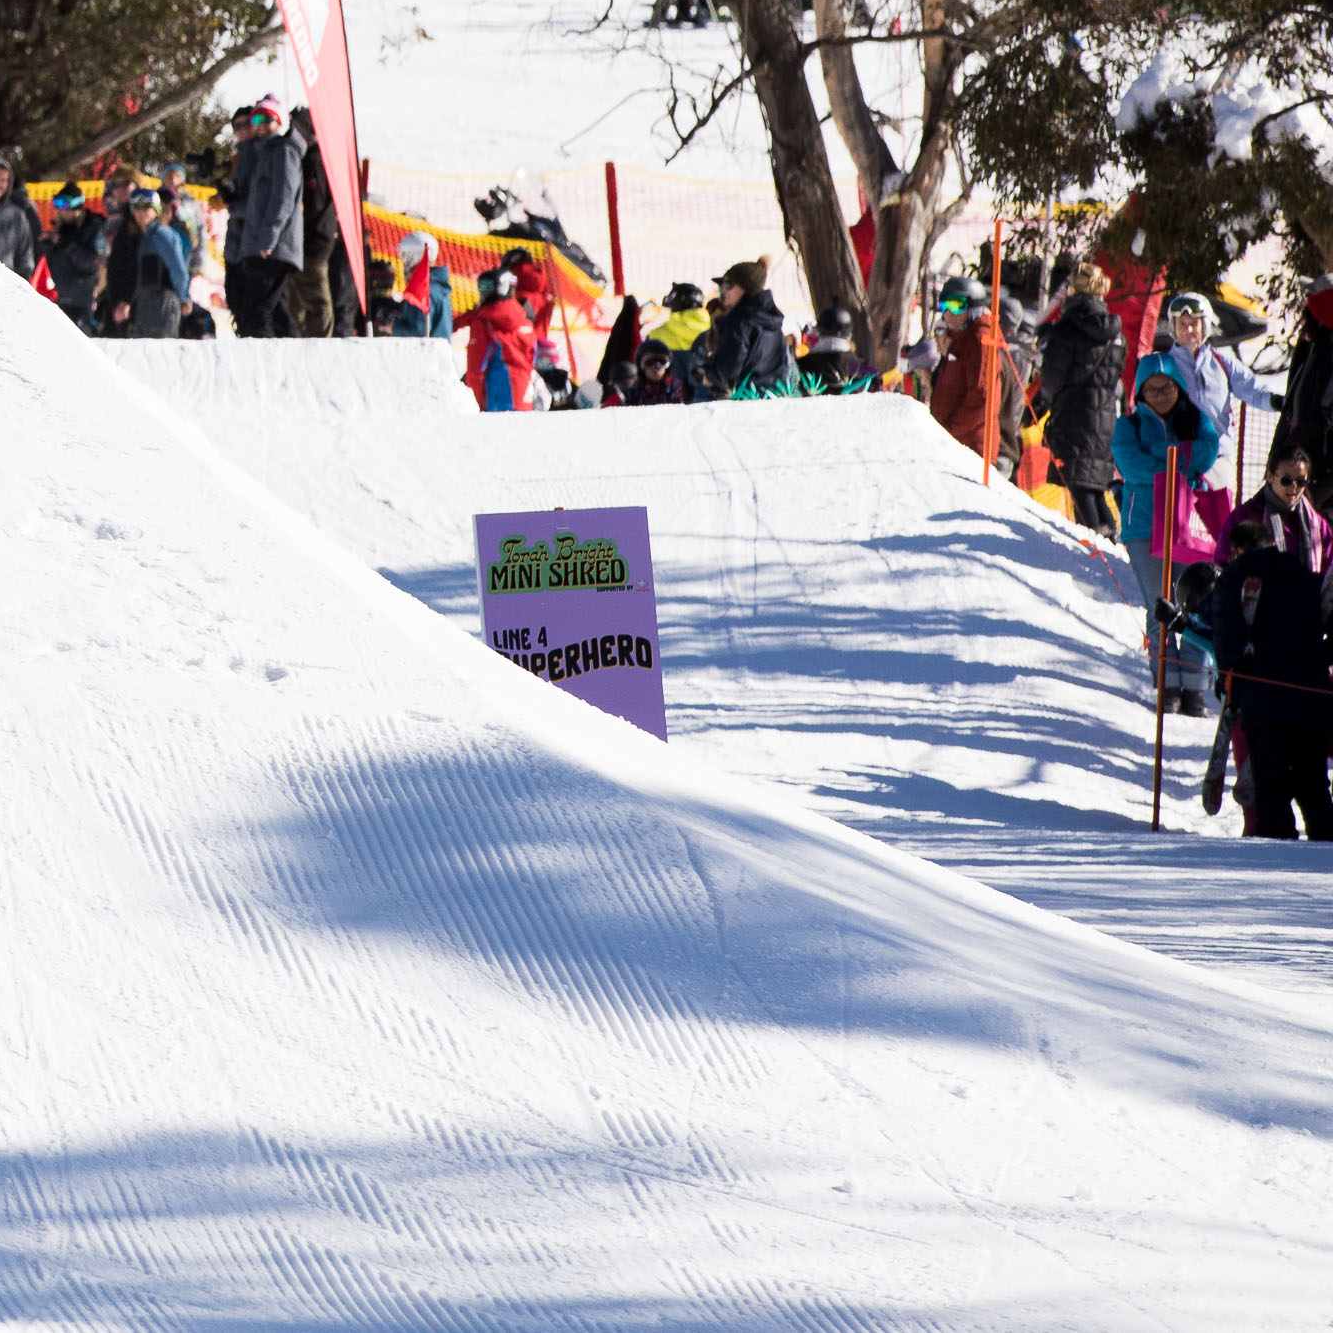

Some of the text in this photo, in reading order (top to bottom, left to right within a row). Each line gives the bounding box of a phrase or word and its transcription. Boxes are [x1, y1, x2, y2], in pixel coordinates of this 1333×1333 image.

[503, 536, 615, 565] Torah Bright
[548, 559, 626, 588] SHRED
[493, 626, 548, 650] LINE 4
